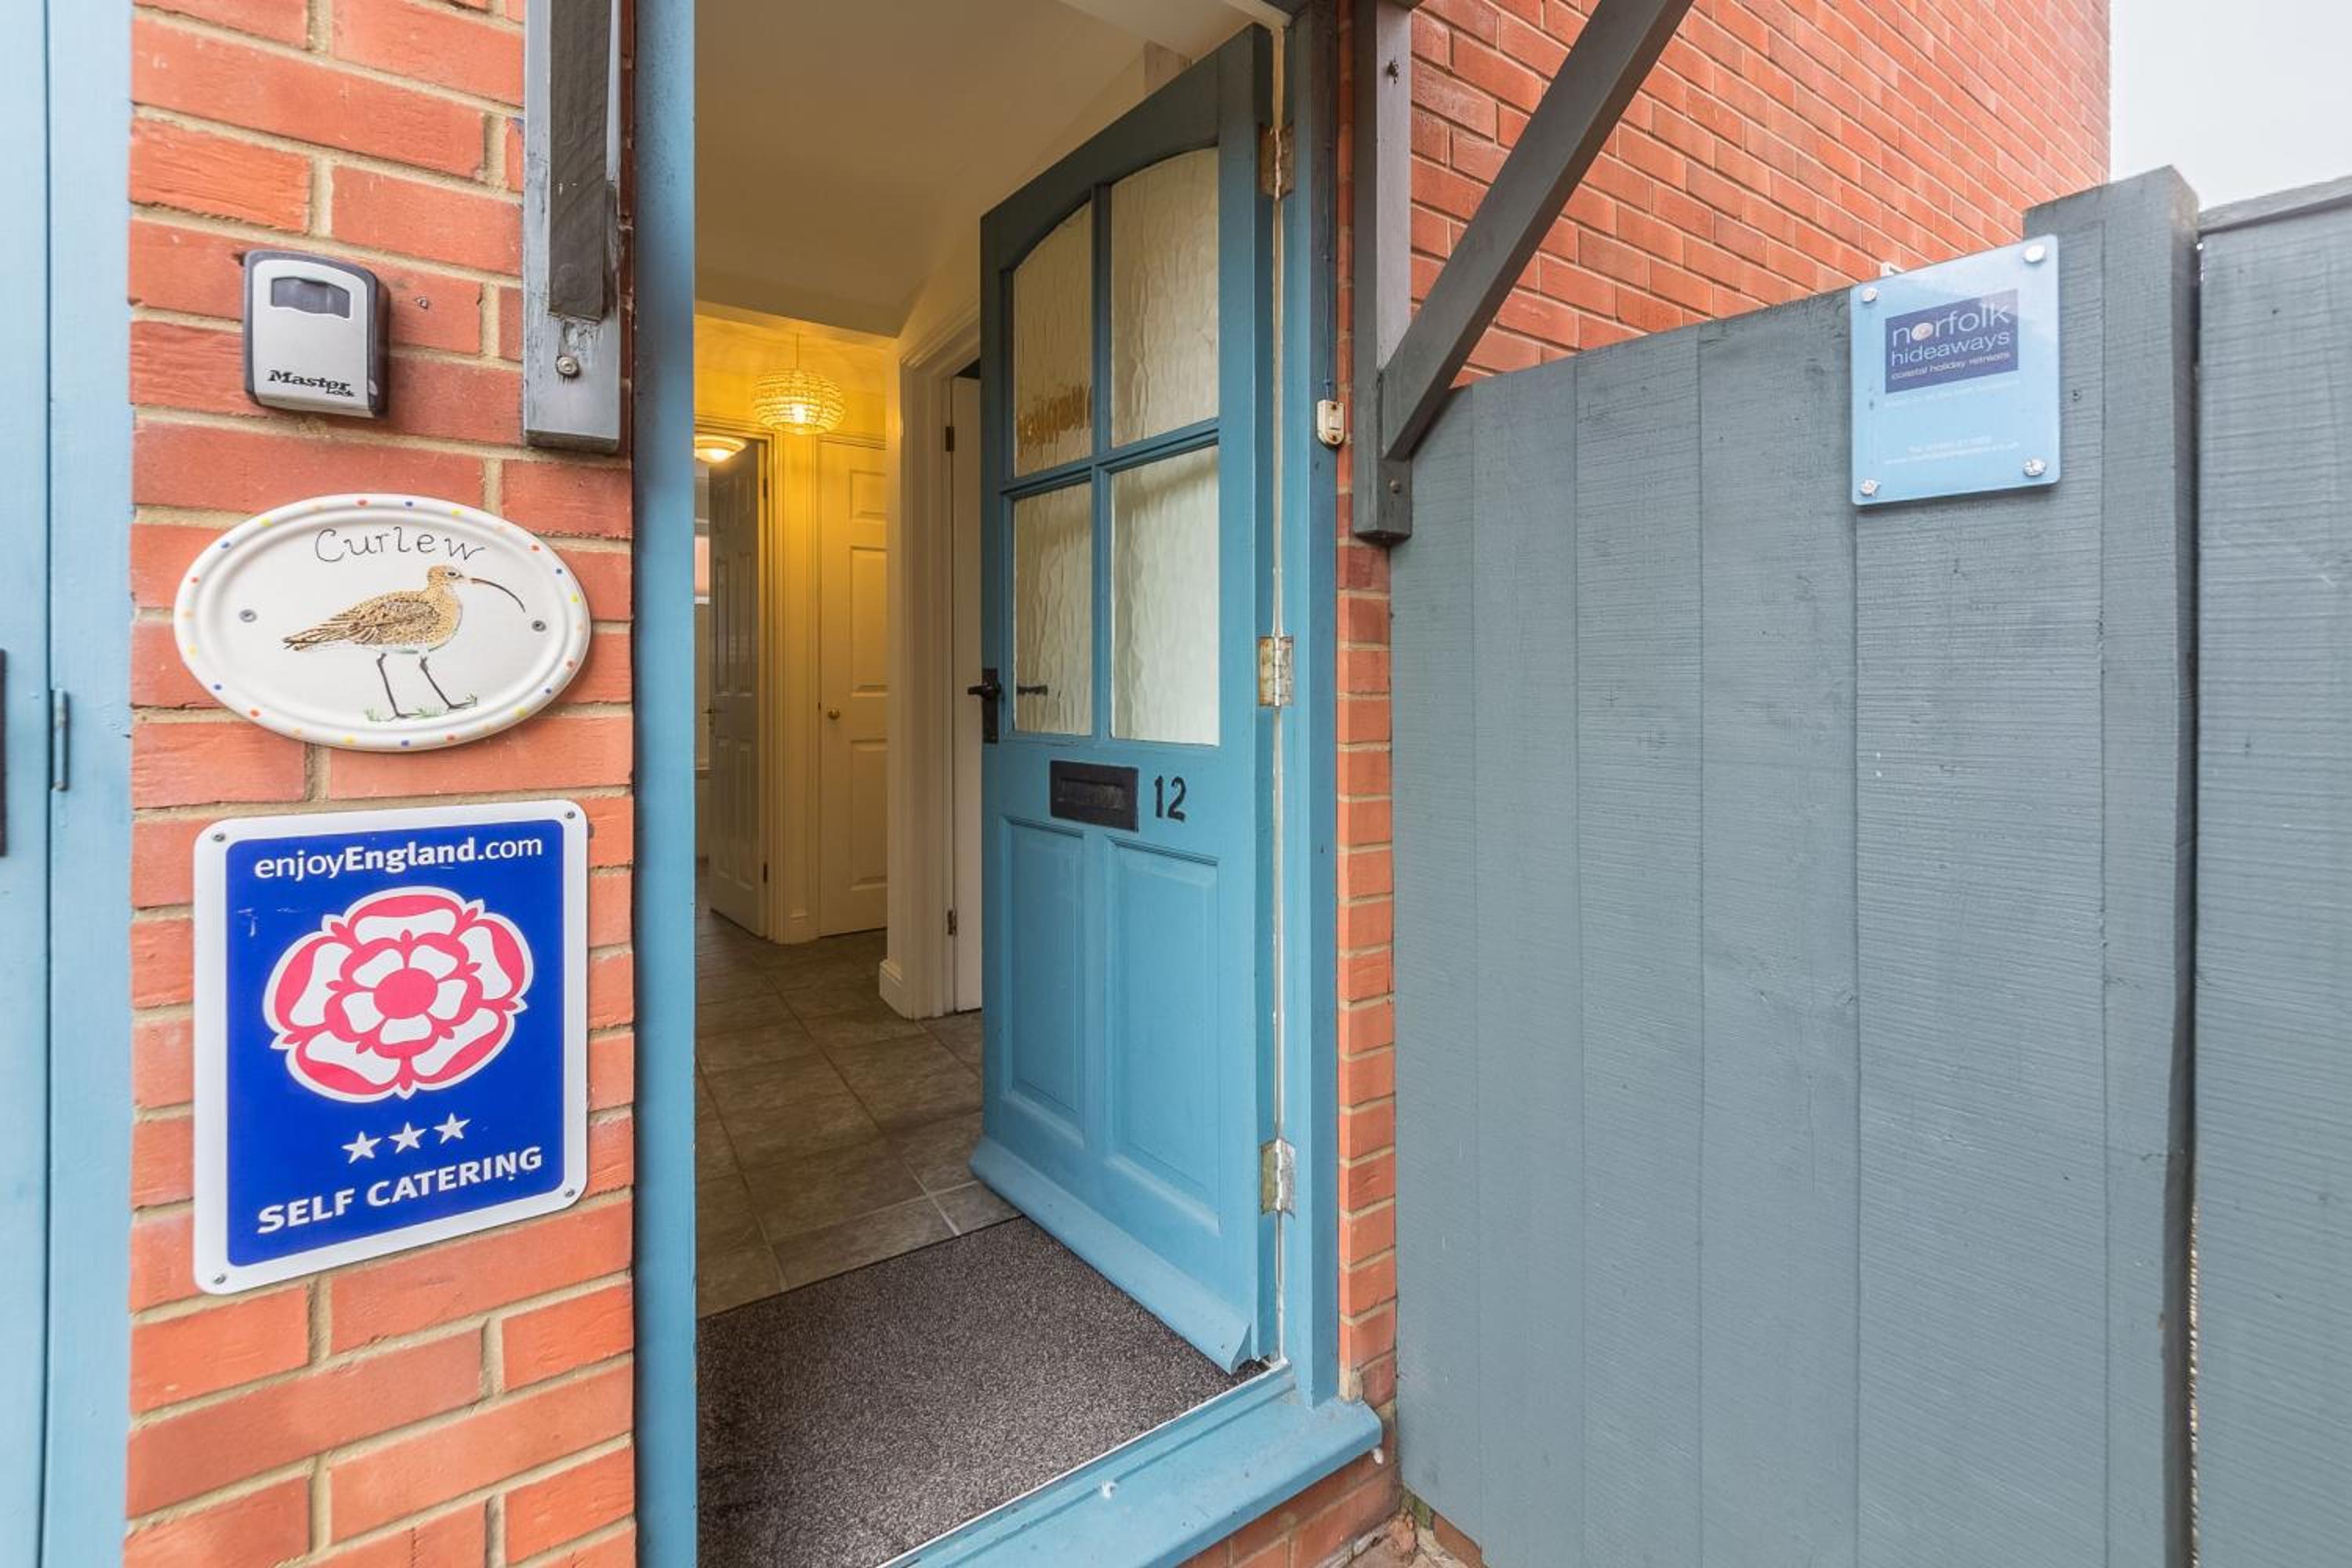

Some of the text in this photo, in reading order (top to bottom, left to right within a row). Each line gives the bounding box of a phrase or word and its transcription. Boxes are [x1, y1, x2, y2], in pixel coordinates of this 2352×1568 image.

[1893, 302, 2010, 347] norfolk
[1891, 331, 2011, 366] hideaways
[1929, 360, 1966, 373] holiday
[268, 369, 351, 390] Master
[314, 526, 486, 563] Curlew
[1154, 775, 1187, 822] 12
[254, 837, 543, 882] enjoyEngland.com
[256, 1145, 542, 1234] SELF CATERING
